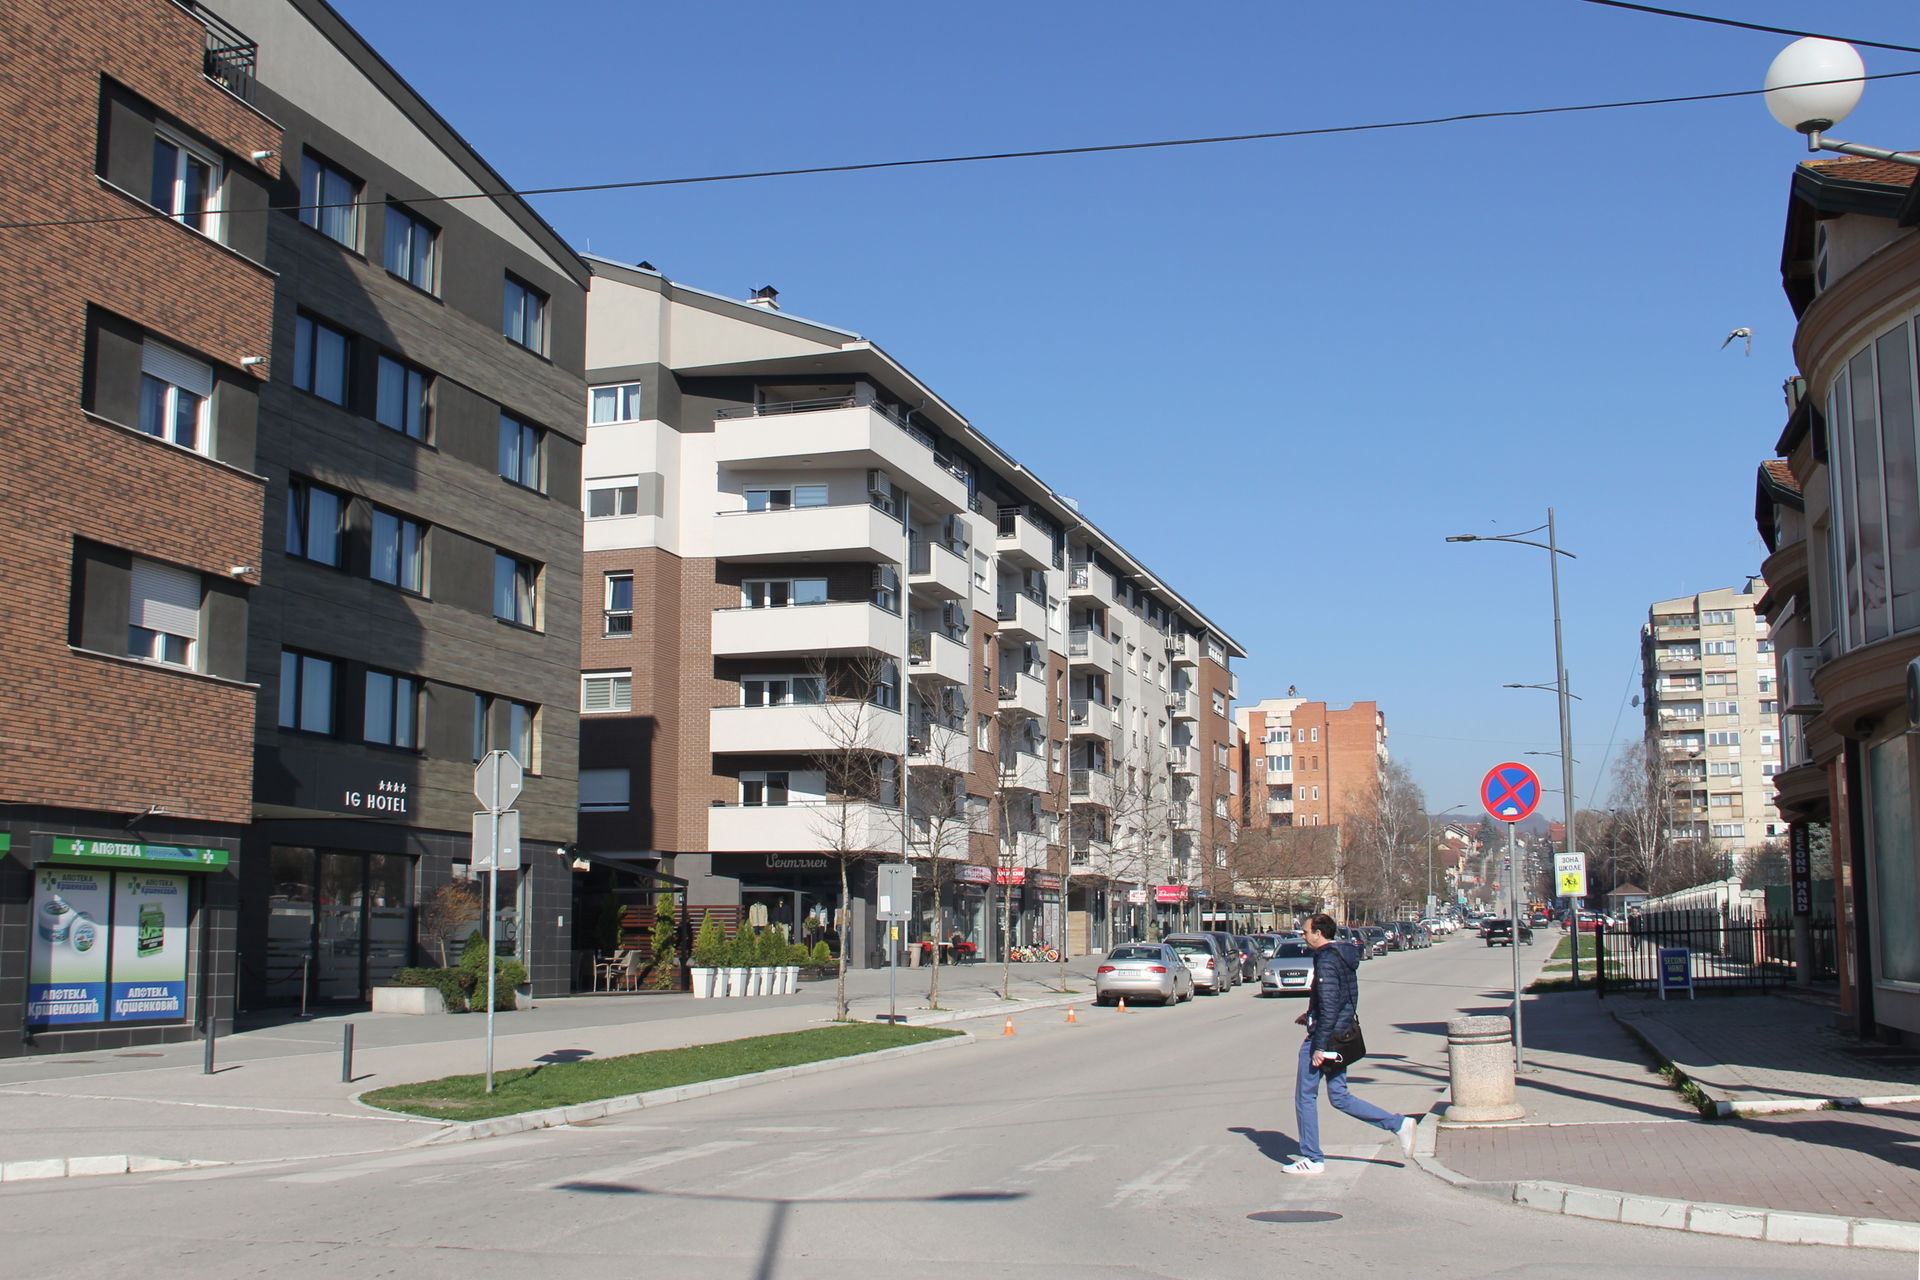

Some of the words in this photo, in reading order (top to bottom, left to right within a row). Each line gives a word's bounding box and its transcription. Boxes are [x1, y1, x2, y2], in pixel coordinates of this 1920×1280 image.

[345, 791, 361, 807] IG
[367, 794, 407, 812] HOTEL
[90, 842, 141, 857] АПОТЕКА
[1795, 828, 1807, 873] SECOND
[1561, 856, 1579, 864] ЗОНА
[62, 873, 94, 882] АПОТЕКА
[145, 879, 174, 887] АПОТЕКА
[1797, 881, 1809, 912] HAND
[42, 989, 87, 1000] АПОТЕКА
[127, 987, 169, 998] АПОТЕКА
[28, 999, 99, 1019] Кршенковић
[115, 996, 179, 1016] Кршенковић
